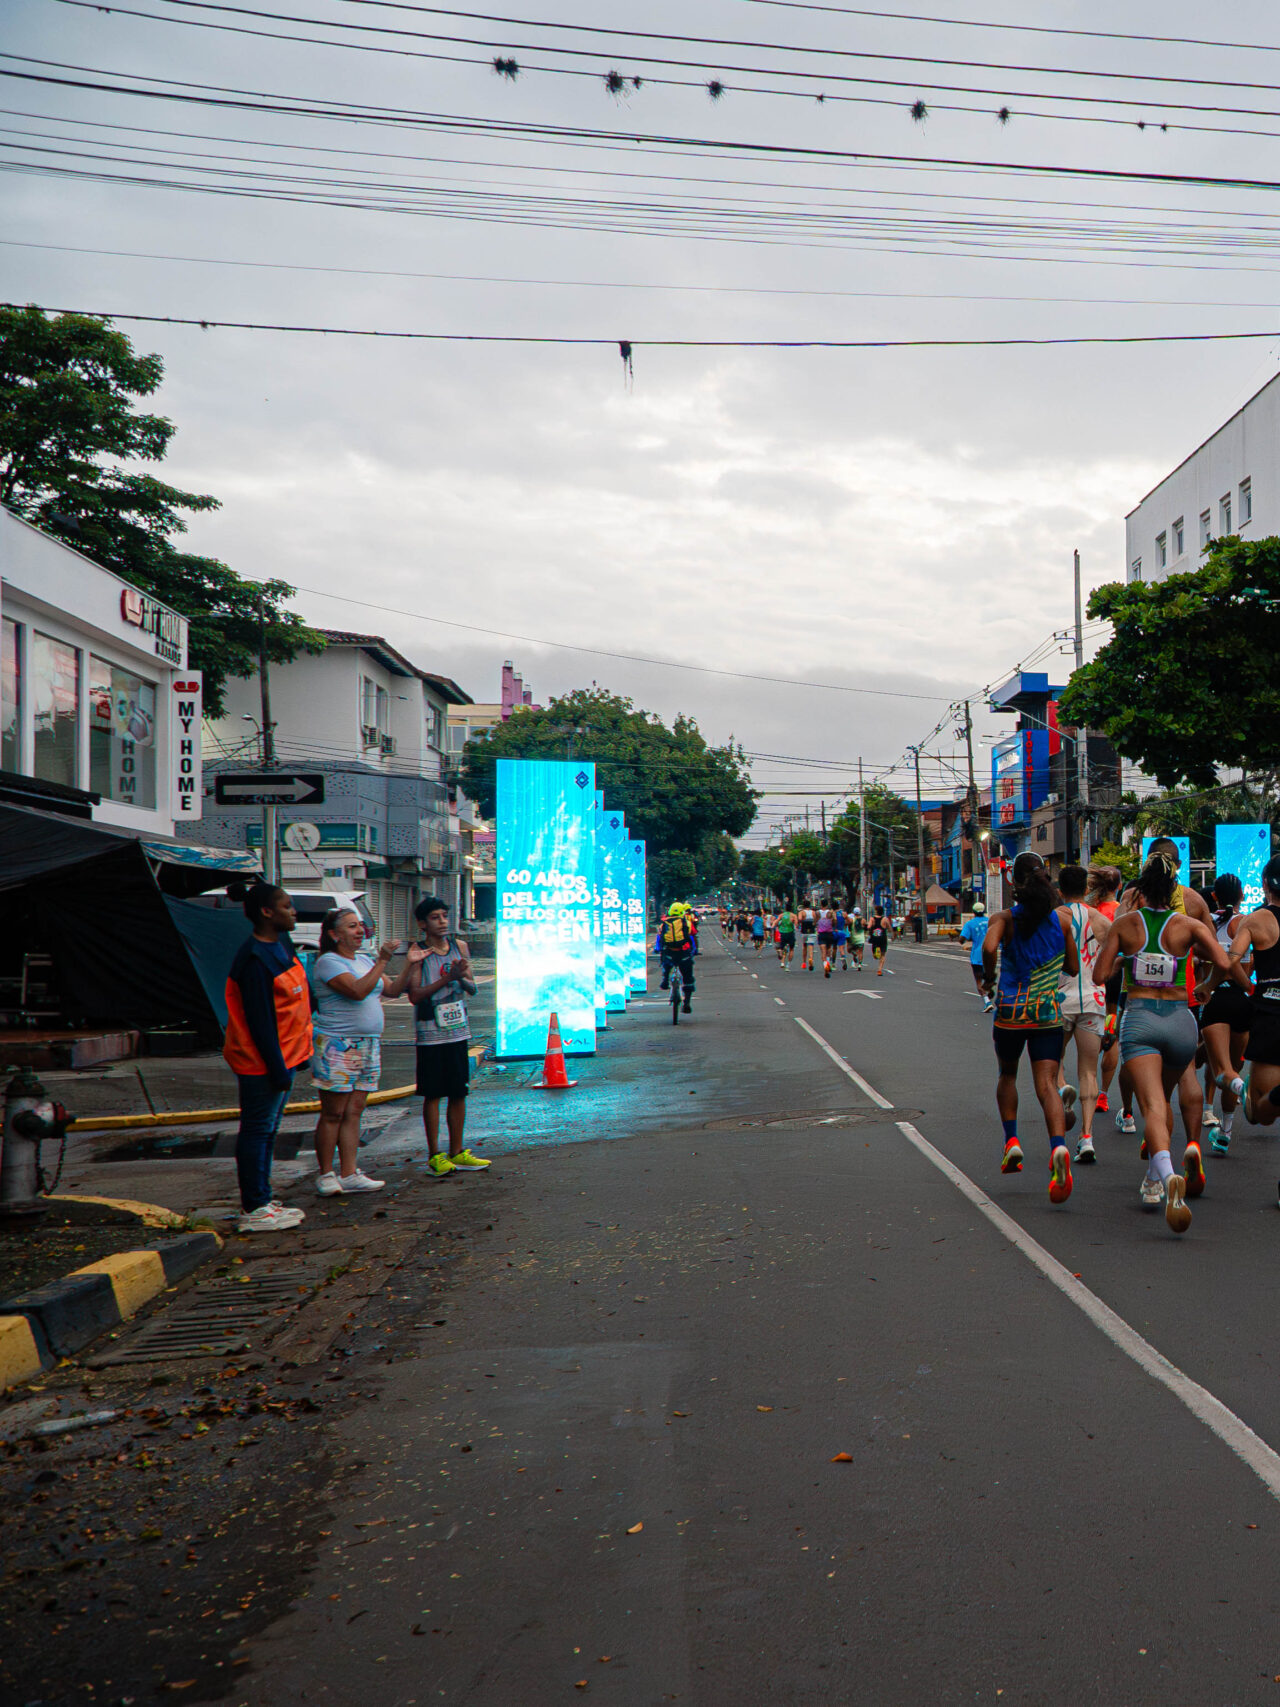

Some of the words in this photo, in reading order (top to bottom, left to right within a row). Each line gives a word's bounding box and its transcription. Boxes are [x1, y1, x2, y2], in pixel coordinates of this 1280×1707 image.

[178, 701, 194, 734] MY
[178, 739, 194, 810] HOME
[506, 869, 531, 885] 60
[534, 869, 587, 890] AÑOS
[503, 892, 538, 906] DEL
[541, 889, 591, 905] LADO
[503, 908, 524, 920] DE
[526, 909, 555, 920] LOS
[558, 909, 590, 922] QUE
[501, 921, 590, 944] HACEN
[1145, 963, 1165, 976] 154
[443, 1010, 462, 1020] 9315
